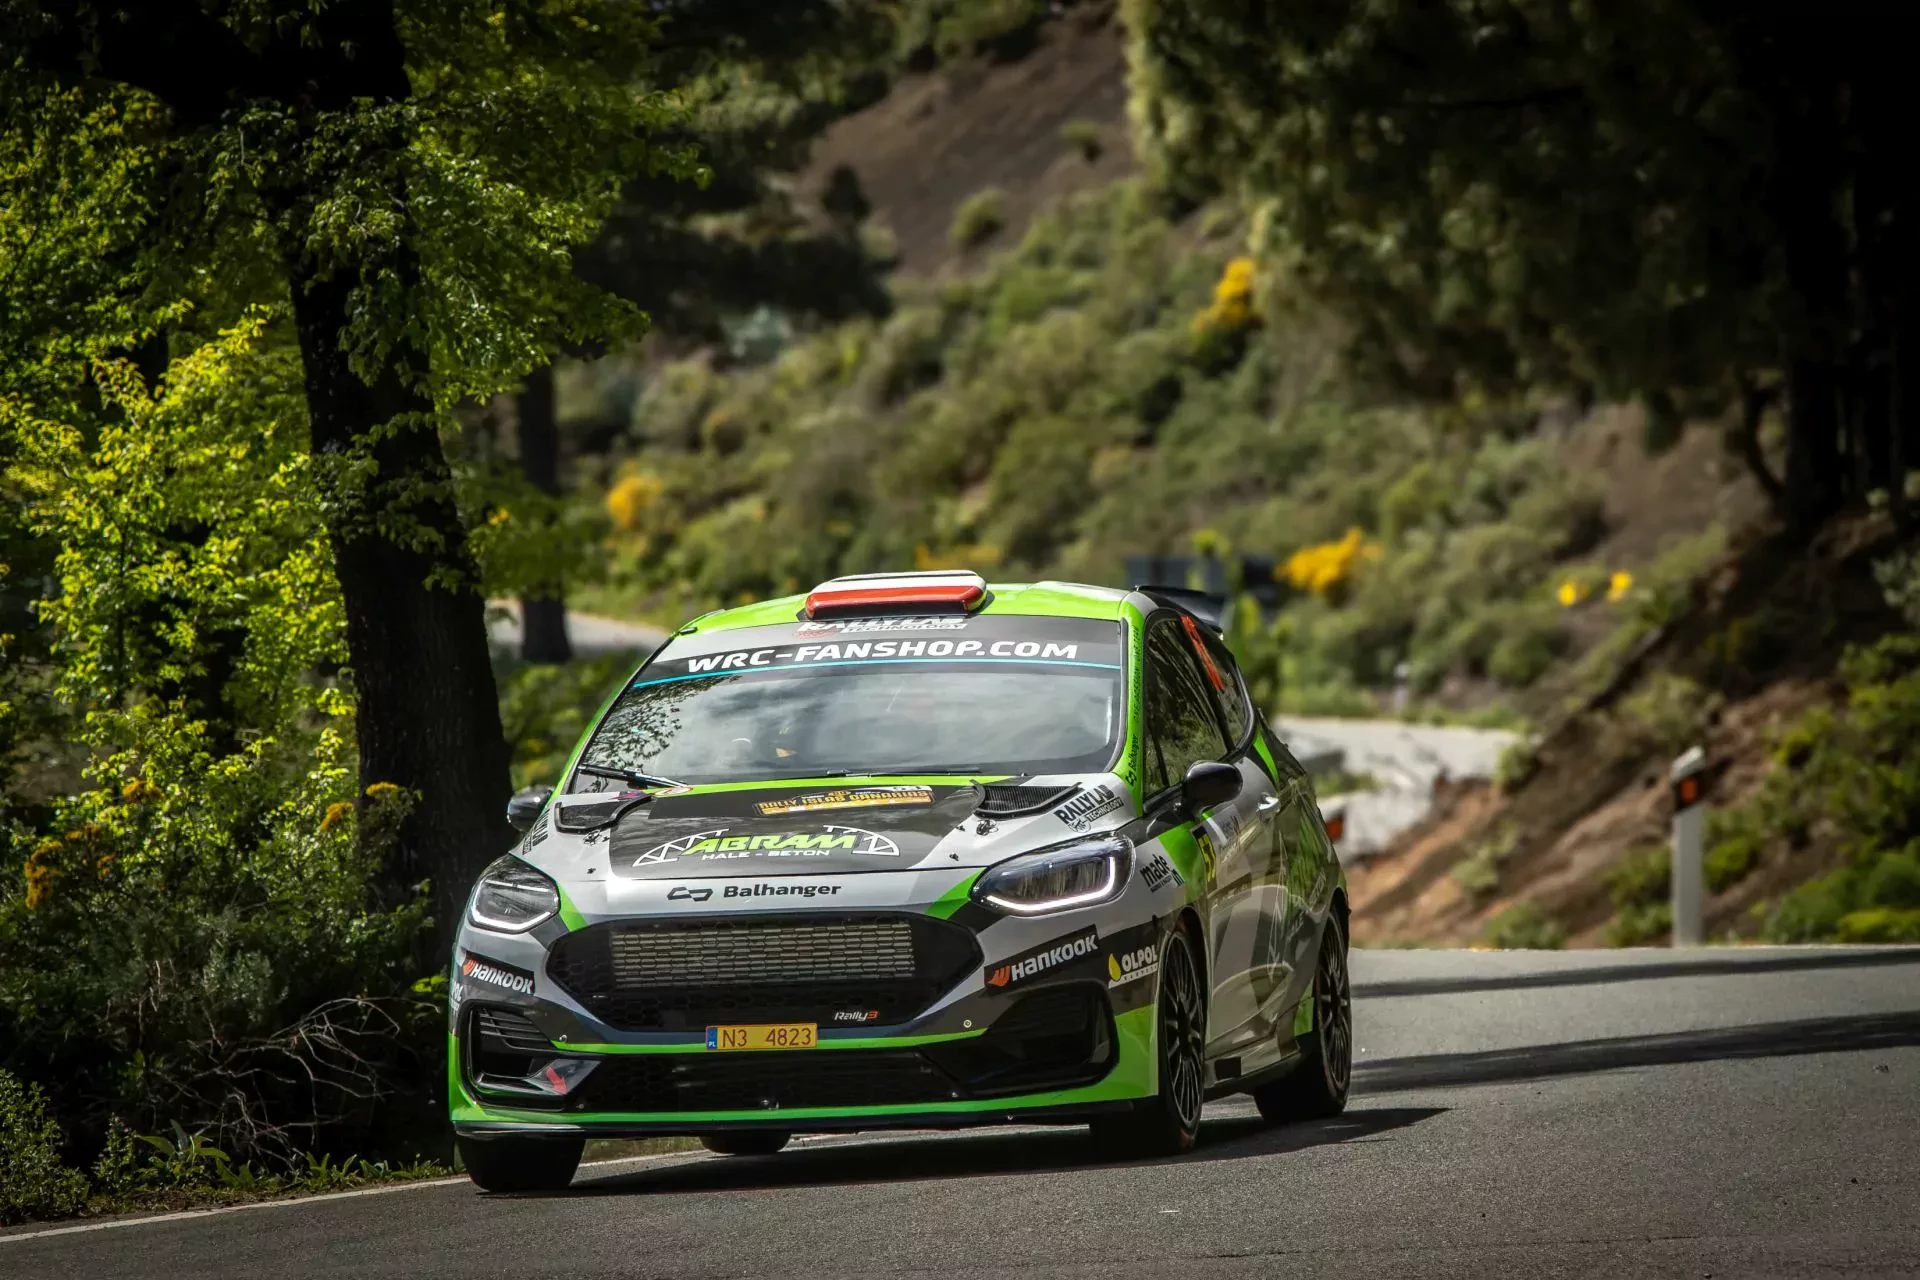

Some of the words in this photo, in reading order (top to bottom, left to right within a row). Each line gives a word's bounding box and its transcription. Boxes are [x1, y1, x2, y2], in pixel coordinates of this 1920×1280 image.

[688, 640, 1078, 673] WRC-FANSHOP.COM
[1085, 798, 1123, 821] TECHNOLOGY
[680, 834, 857, 856] ABRAM
[702, 851, 750, 861] HALE
[1140, 853, 1170, 888] made
[723, 883, 842, 898] Balhanger
[1121, 945, 1158, 972] OLPOL
[833, 1010, 879, 1022] Rally3
[722, 1029, 748, 1048] N3
[765, 1028, 812, 1047] 4823
